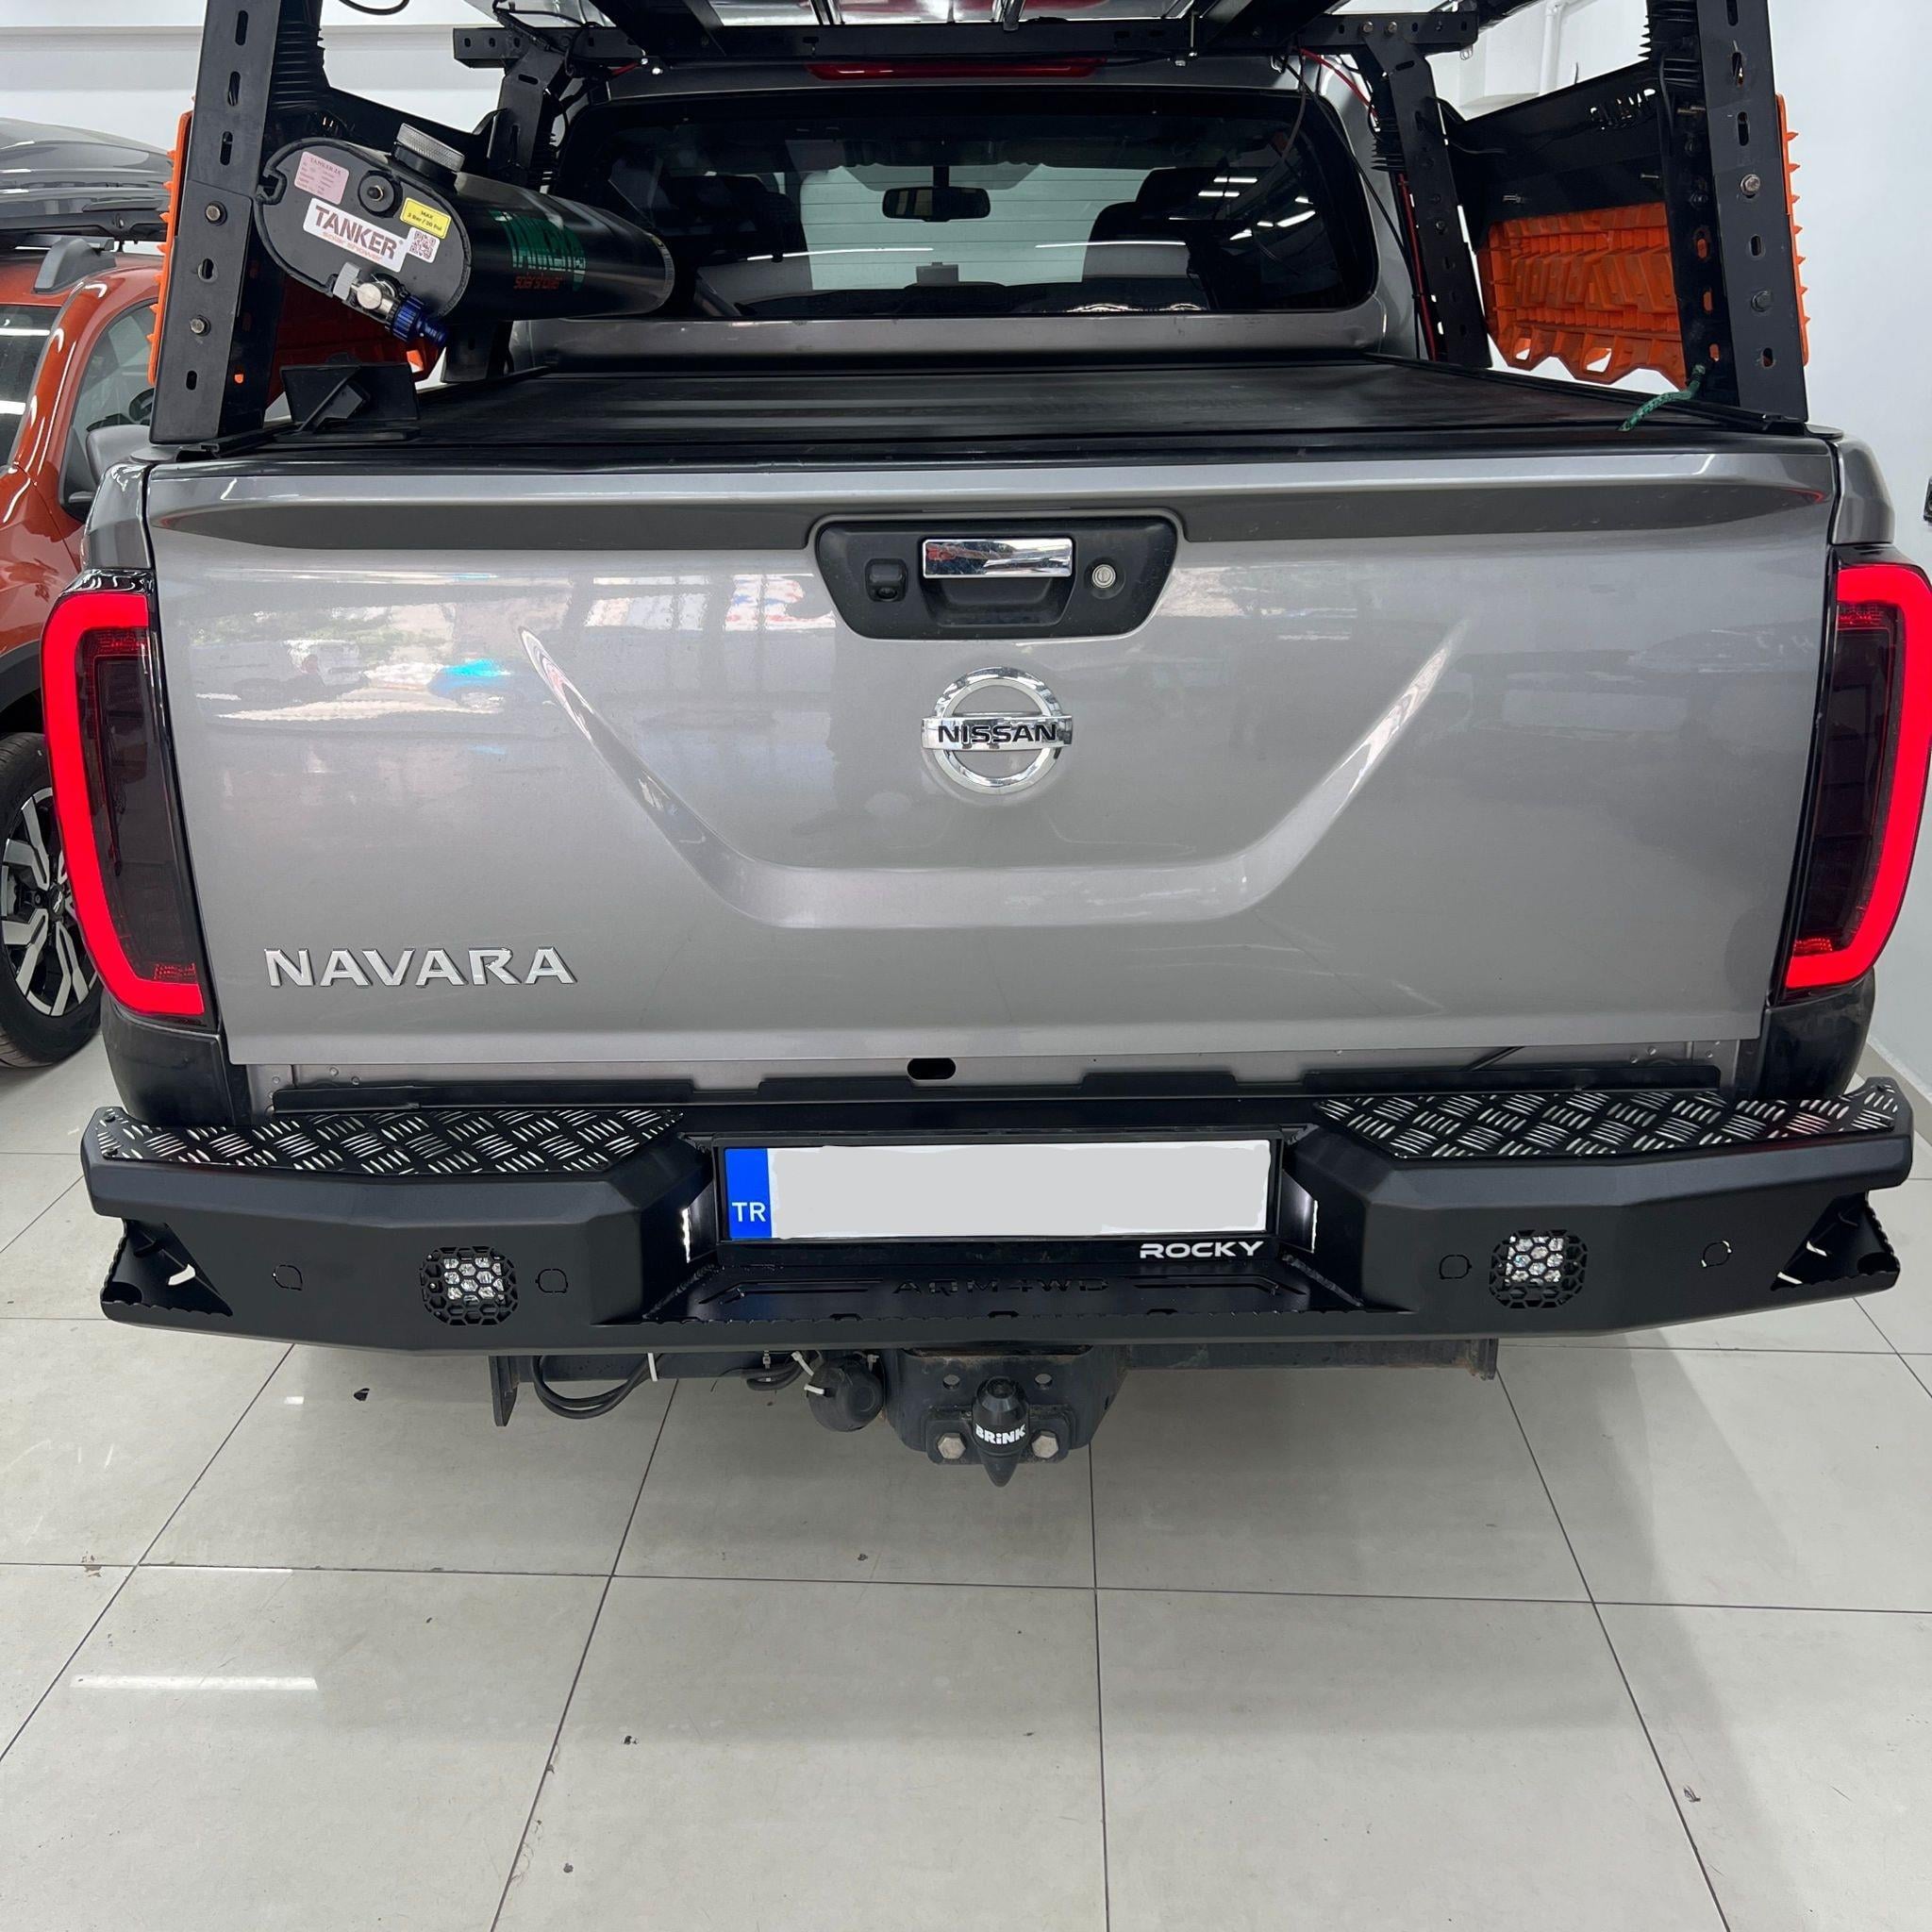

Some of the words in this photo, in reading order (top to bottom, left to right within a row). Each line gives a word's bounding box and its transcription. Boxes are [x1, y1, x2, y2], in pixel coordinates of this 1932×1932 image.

[315, 205, 397, 259] TANKER
[938, 724, 1057, 743] NISSAN
[263, 946, 578, 986] NAVARA
[731, 1201, 766, 1224] TR
[1139, 1241, 1264, 1259] ROCKY
